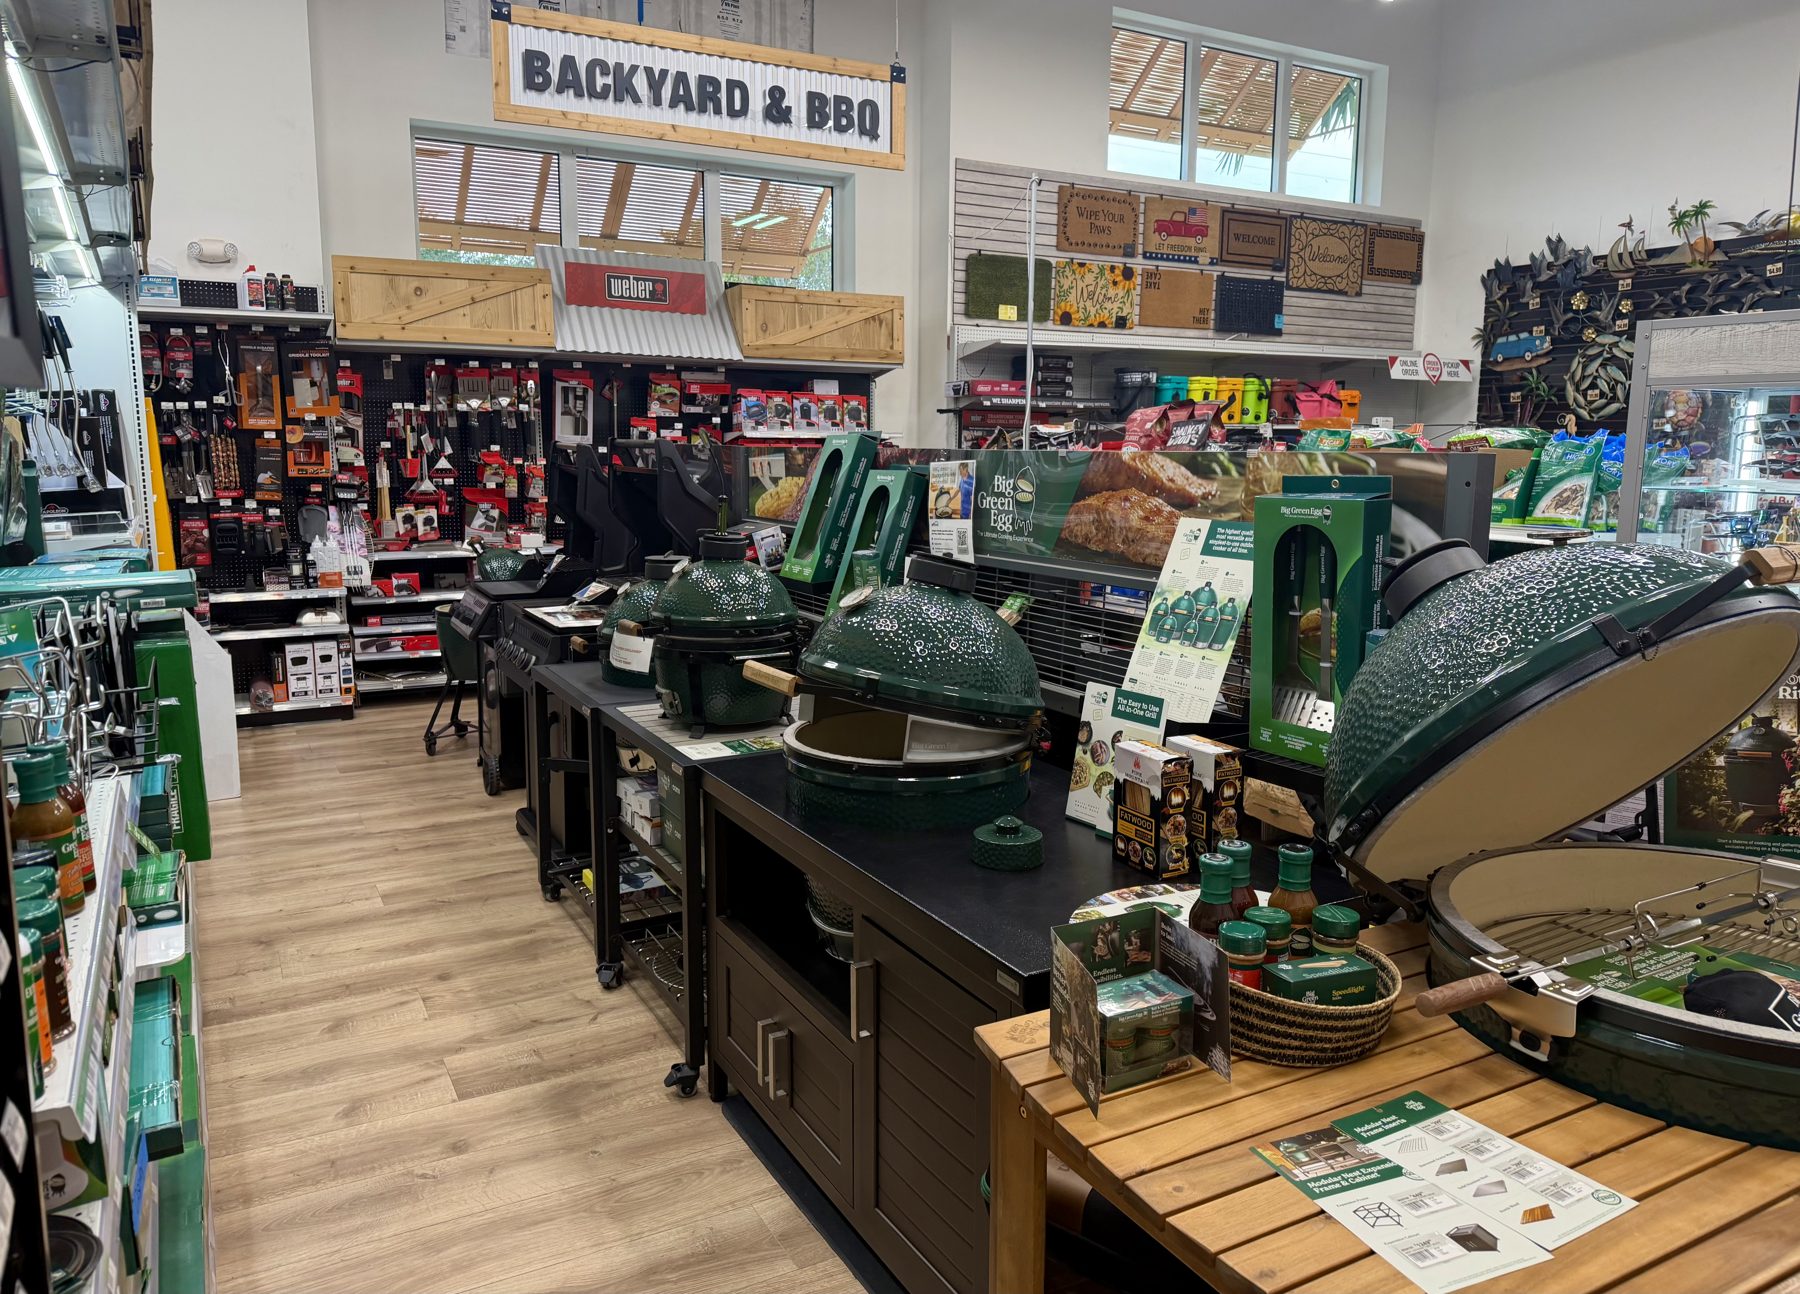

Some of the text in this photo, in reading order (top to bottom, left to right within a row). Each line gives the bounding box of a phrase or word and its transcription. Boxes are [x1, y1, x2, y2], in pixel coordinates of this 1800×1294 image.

[525, 48, 881, 140] BACKYARD & BBQ
[1233, 233, 1276, 246] WELCOME
[1155, 243, 1166, 251] LET
[1167, 244, 1192, 253] FREEDOM
[1307, 243, 1350, 265] Welcome
[1146, 271, 1162, 280] CARE
[610, 276, 652, 299] weber
[1073, 277, 1121, 308] Welcome
[1199, 307, 1210, 316] HEY
[1192, 316, 1209, 325] THERE
[1400, 360, 1418, 368] ONLINE
[1443, 361, 1460, 370] PICKUP
[1401, 368, 1420, 377] ORDER
[1446, 370, 1460, 378] HERE
[1171, 423, 1206, 437] SMOKEY
[1166, 433, 1199, 446] WOODS
[994, 475, 1015, 497] Big
[978, 492, 1014, 511] Green
[1281, 506, 1291, 515] Big
[1291, 507, 1310, 515] Green
[1310, 507, 1323, 517] Egg
[990, 510, 1013, 532] Egg
[1117, 696, 1159, 712] The Easy to Use
[1117, 704, 1157, 719] All-In-One Grill
[171, 789, 181, 829] FRAGILE
[1120, 810, 1152, 830] FATWOOD
[1093, 967, 1117, 977] Endless
[1332, 985, 1365, 997] Speedilight
[1353, 1114, 1398, 1133] Modular Nest
[1361, 1126, 1384, 1138] Frame
[1382, 1118, 1407, 1130] Inserts
[1306, 1168, 1361, 1188] Modular Nest
[1313, 1173, 1380, 1194] Frame & Cabinet
